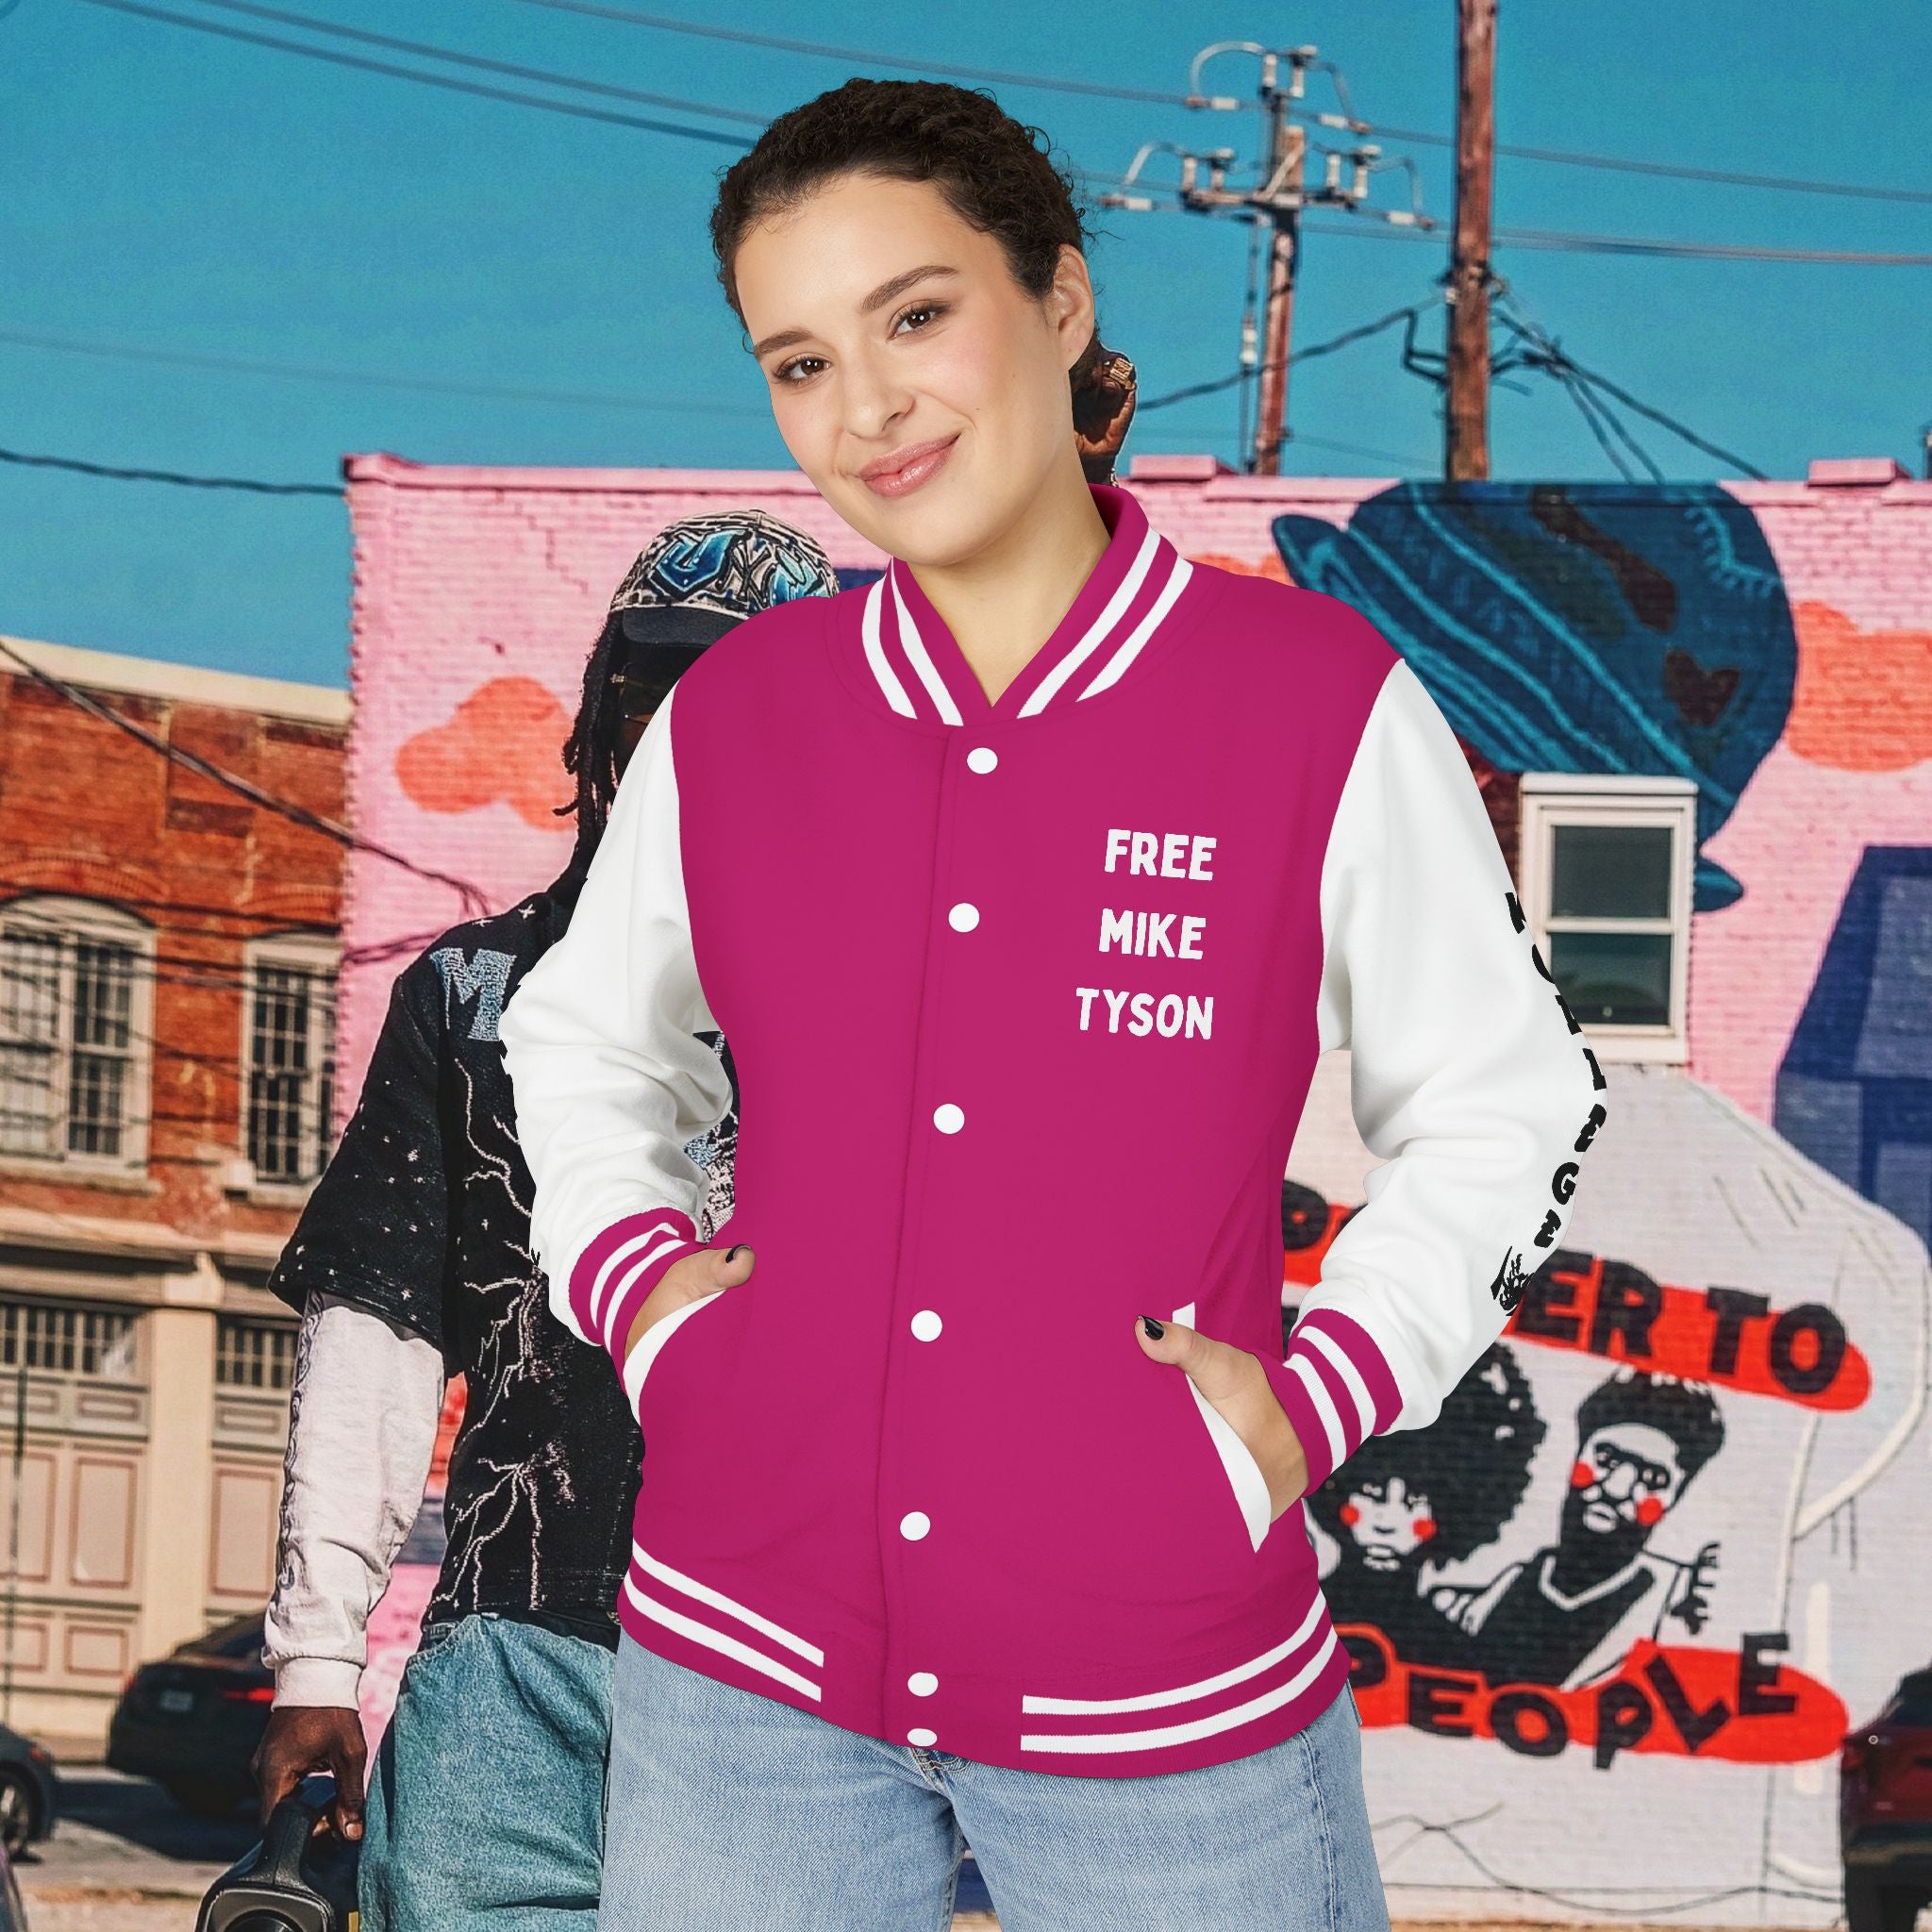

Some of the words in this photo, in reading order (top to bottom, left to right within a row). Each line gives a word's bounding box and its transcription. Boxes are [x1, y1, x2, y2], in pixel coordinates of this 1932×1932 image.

[1104, 828, 1217, 881] FREE
[1098, 908, 1207, 960] MIKE
[1075, 987, 1214, 1041] TYSON
[1706, 1285, 1847, 1396] TO
